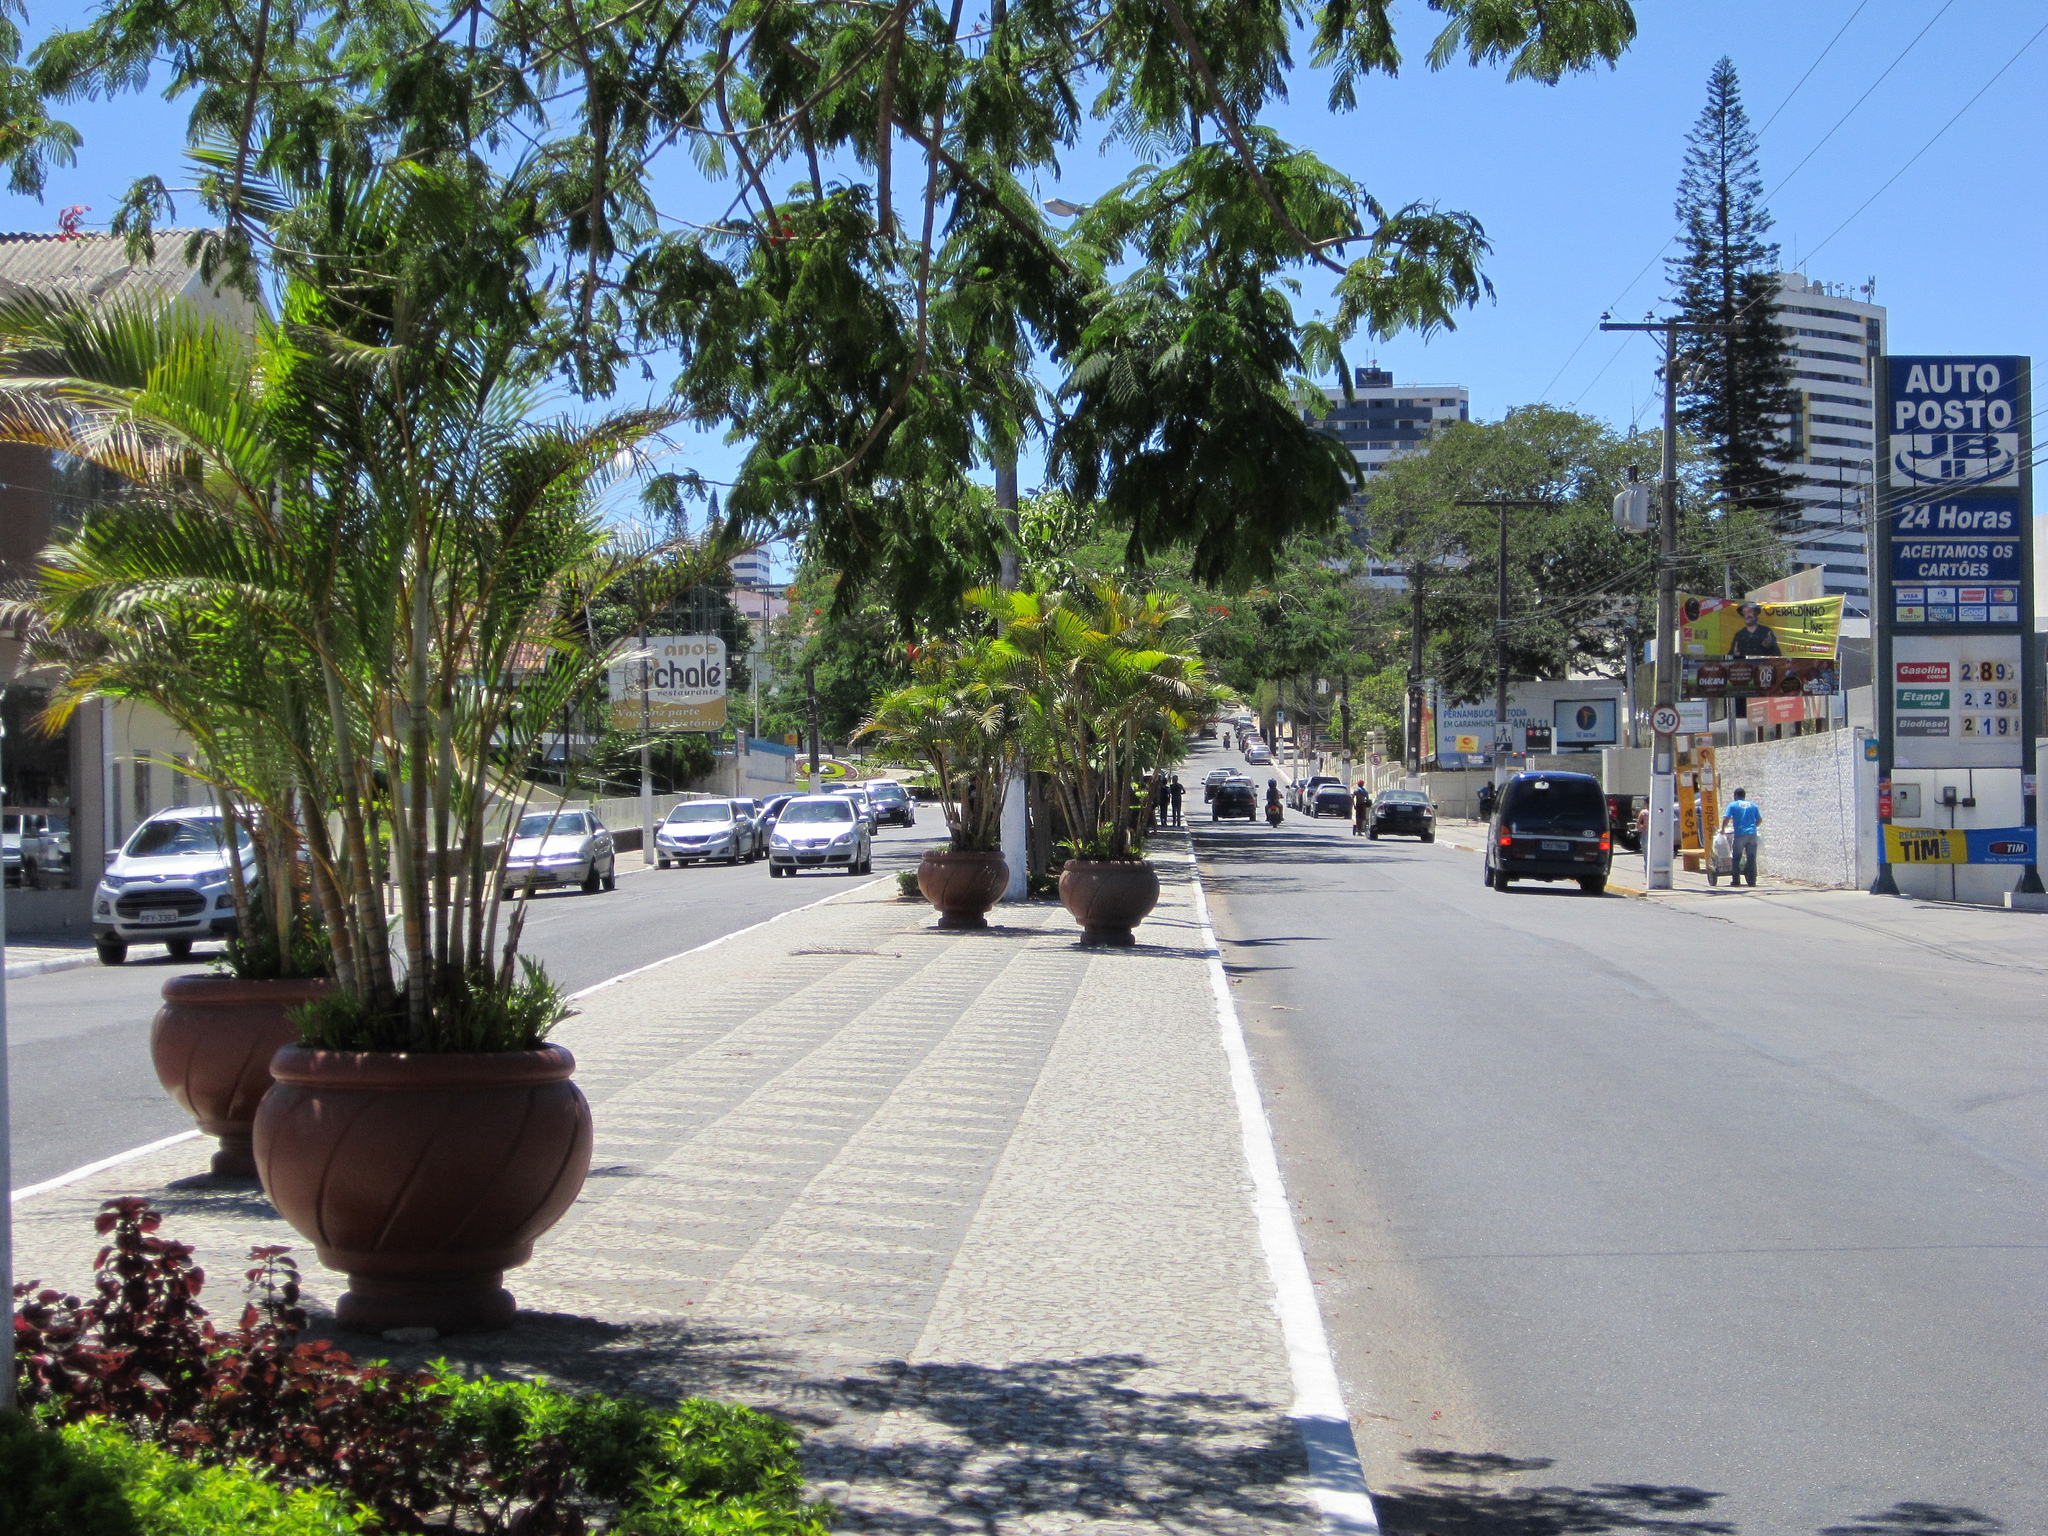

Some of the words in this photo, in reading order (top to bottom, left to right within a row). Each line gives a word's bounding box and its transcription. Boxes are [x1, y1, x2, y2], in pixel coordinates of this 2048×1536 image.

[1905, 364, 2000, 393] AUTO
[1896, 400, 2012, 430] POSTO
[1899, 505, 1930, 529] 24
[1938, 505, 2012, 529] Horas
[1900, 545, 1988, 559] ACEITAMOS
[1992, 545, 2013, 559] OS
[1918, 560, 1989, 577] CARTÕES
[1962, 608, 1985, 616] Good
[664, 643, 718, 656] anos
[654, 658, 721, 689] chalé
[1900, 666, 1948, 675] Gasolina
[657, 689, 719, 697] restaurante
[1902, 692, 1945, 701] Etanol
[668, 708, 700, 718] parte
[1443, 709, 1498, 719] PERNAMBUCAN
[1507, 709, 1528, 717] TODA
[1443, 720, 1454, 728] EM
[1657, 712, 1676, 727] 30
[1900, 720, 1948, 728] Biodiesel
[1899, 830, 1937, 839] RECARGA
[1900, 839, 1940, 861] TIM
[2006, 843, 2024, 852] TIM
